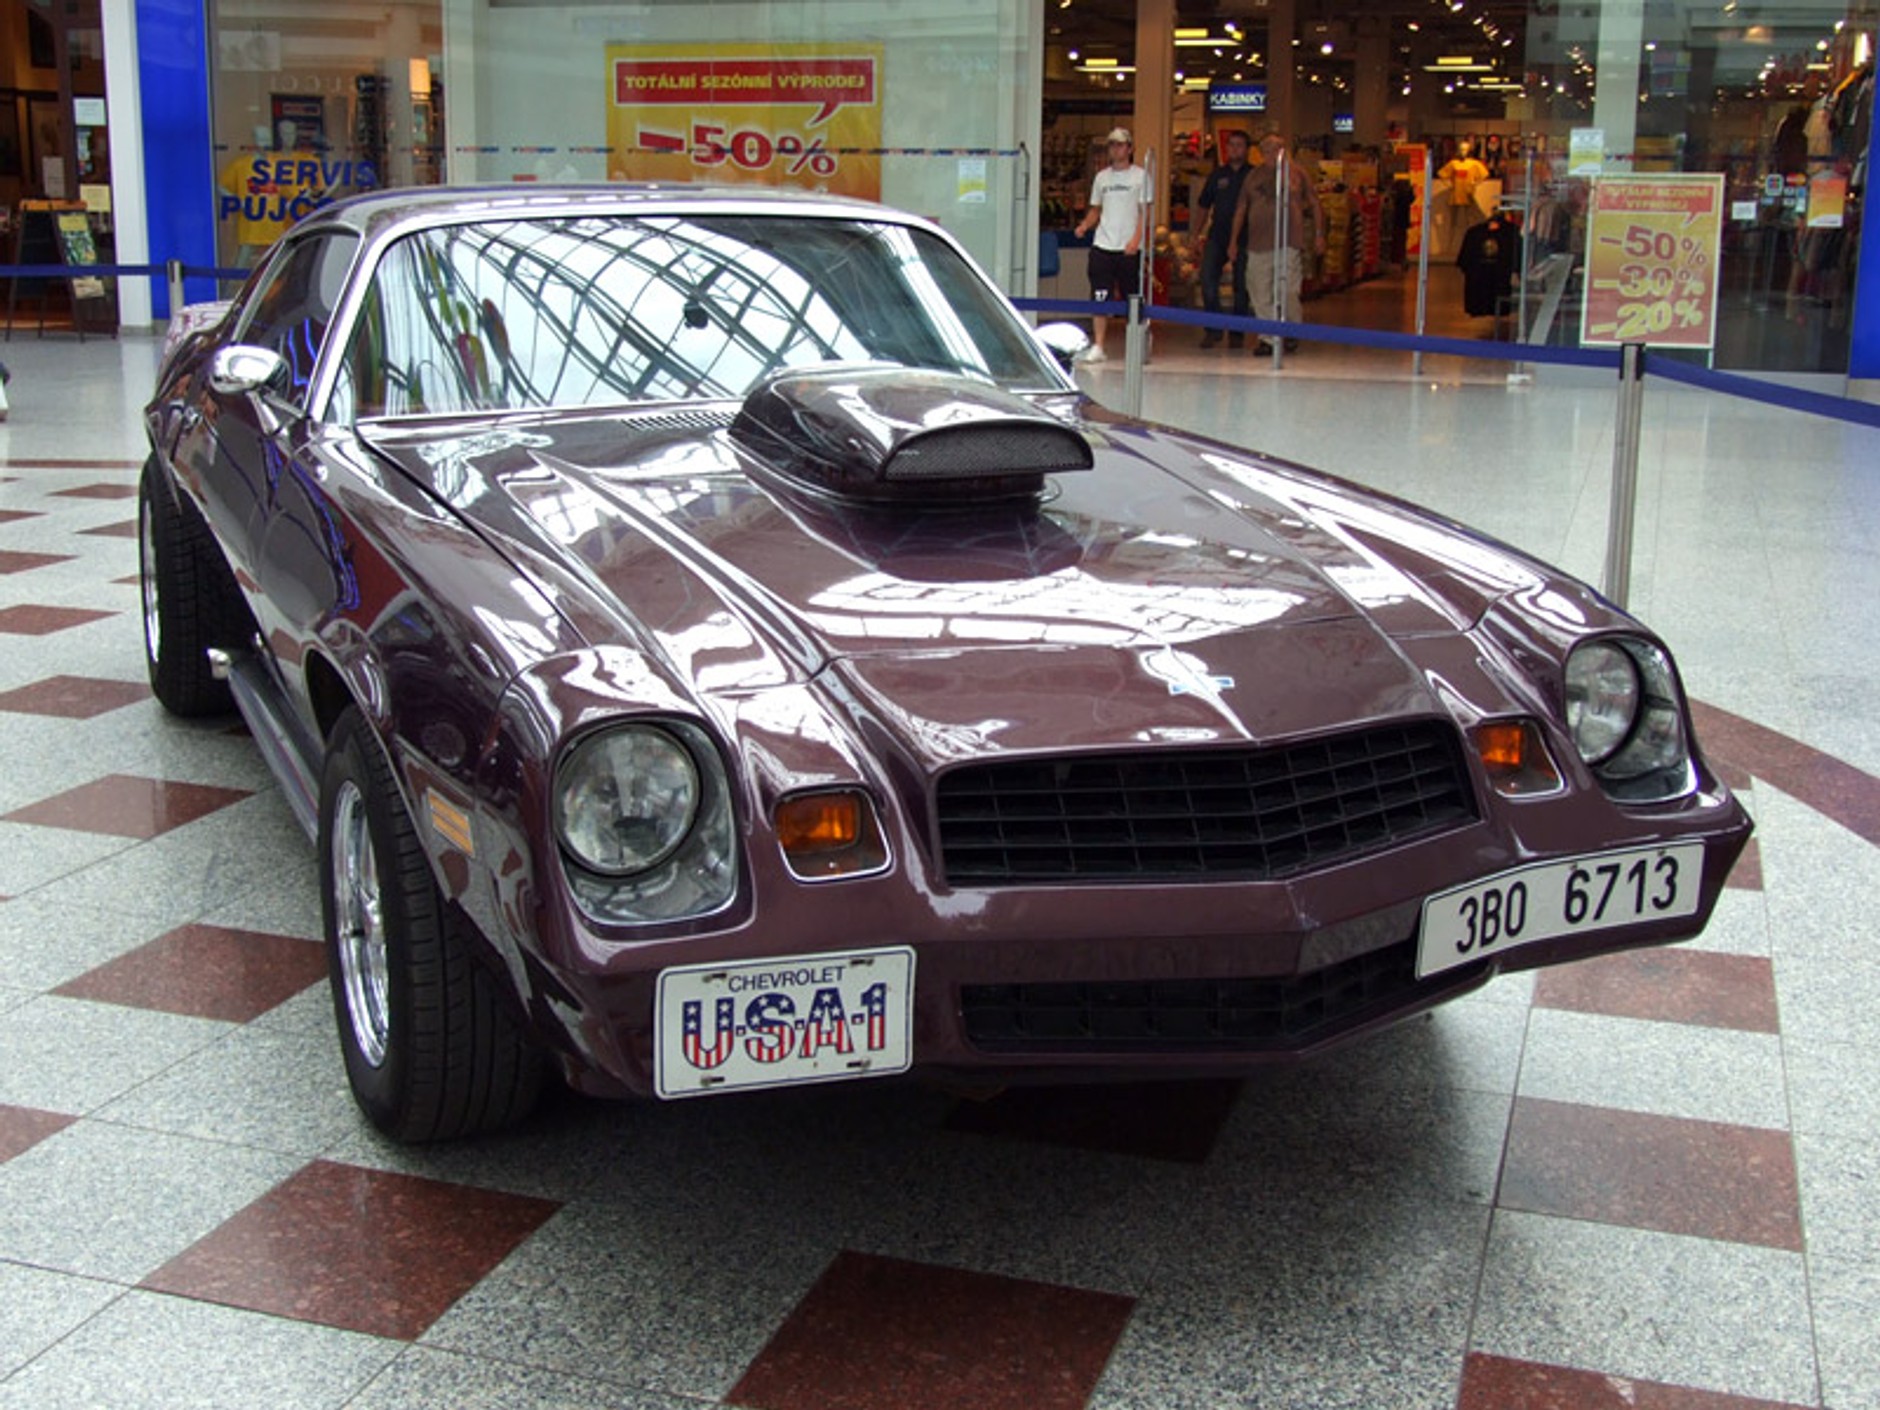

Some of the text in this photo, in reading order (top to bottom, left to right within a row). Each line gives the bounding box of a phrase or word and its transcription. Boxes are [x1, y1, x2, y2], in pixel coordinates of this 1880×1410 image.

[624, 73, 866, 89] TOTÁLNÍ SEZÓNNÍ VÝPRODEJ
[1210, 93, 1266, 105] KABINKY
[639, 124, 836, 174] -50%
[251, 159, 377, 187] SERVIS
[220, 186, 336, 222] PŮJČ
[1599, 225, 1707, 266] -50%
[1593, 265, 1706, 298] -30%
[1590, 299, 1703, 339] -20%
[1564, 855, 1679, 924] 6713
[727, 965, 847, 993] CHEVROLET
